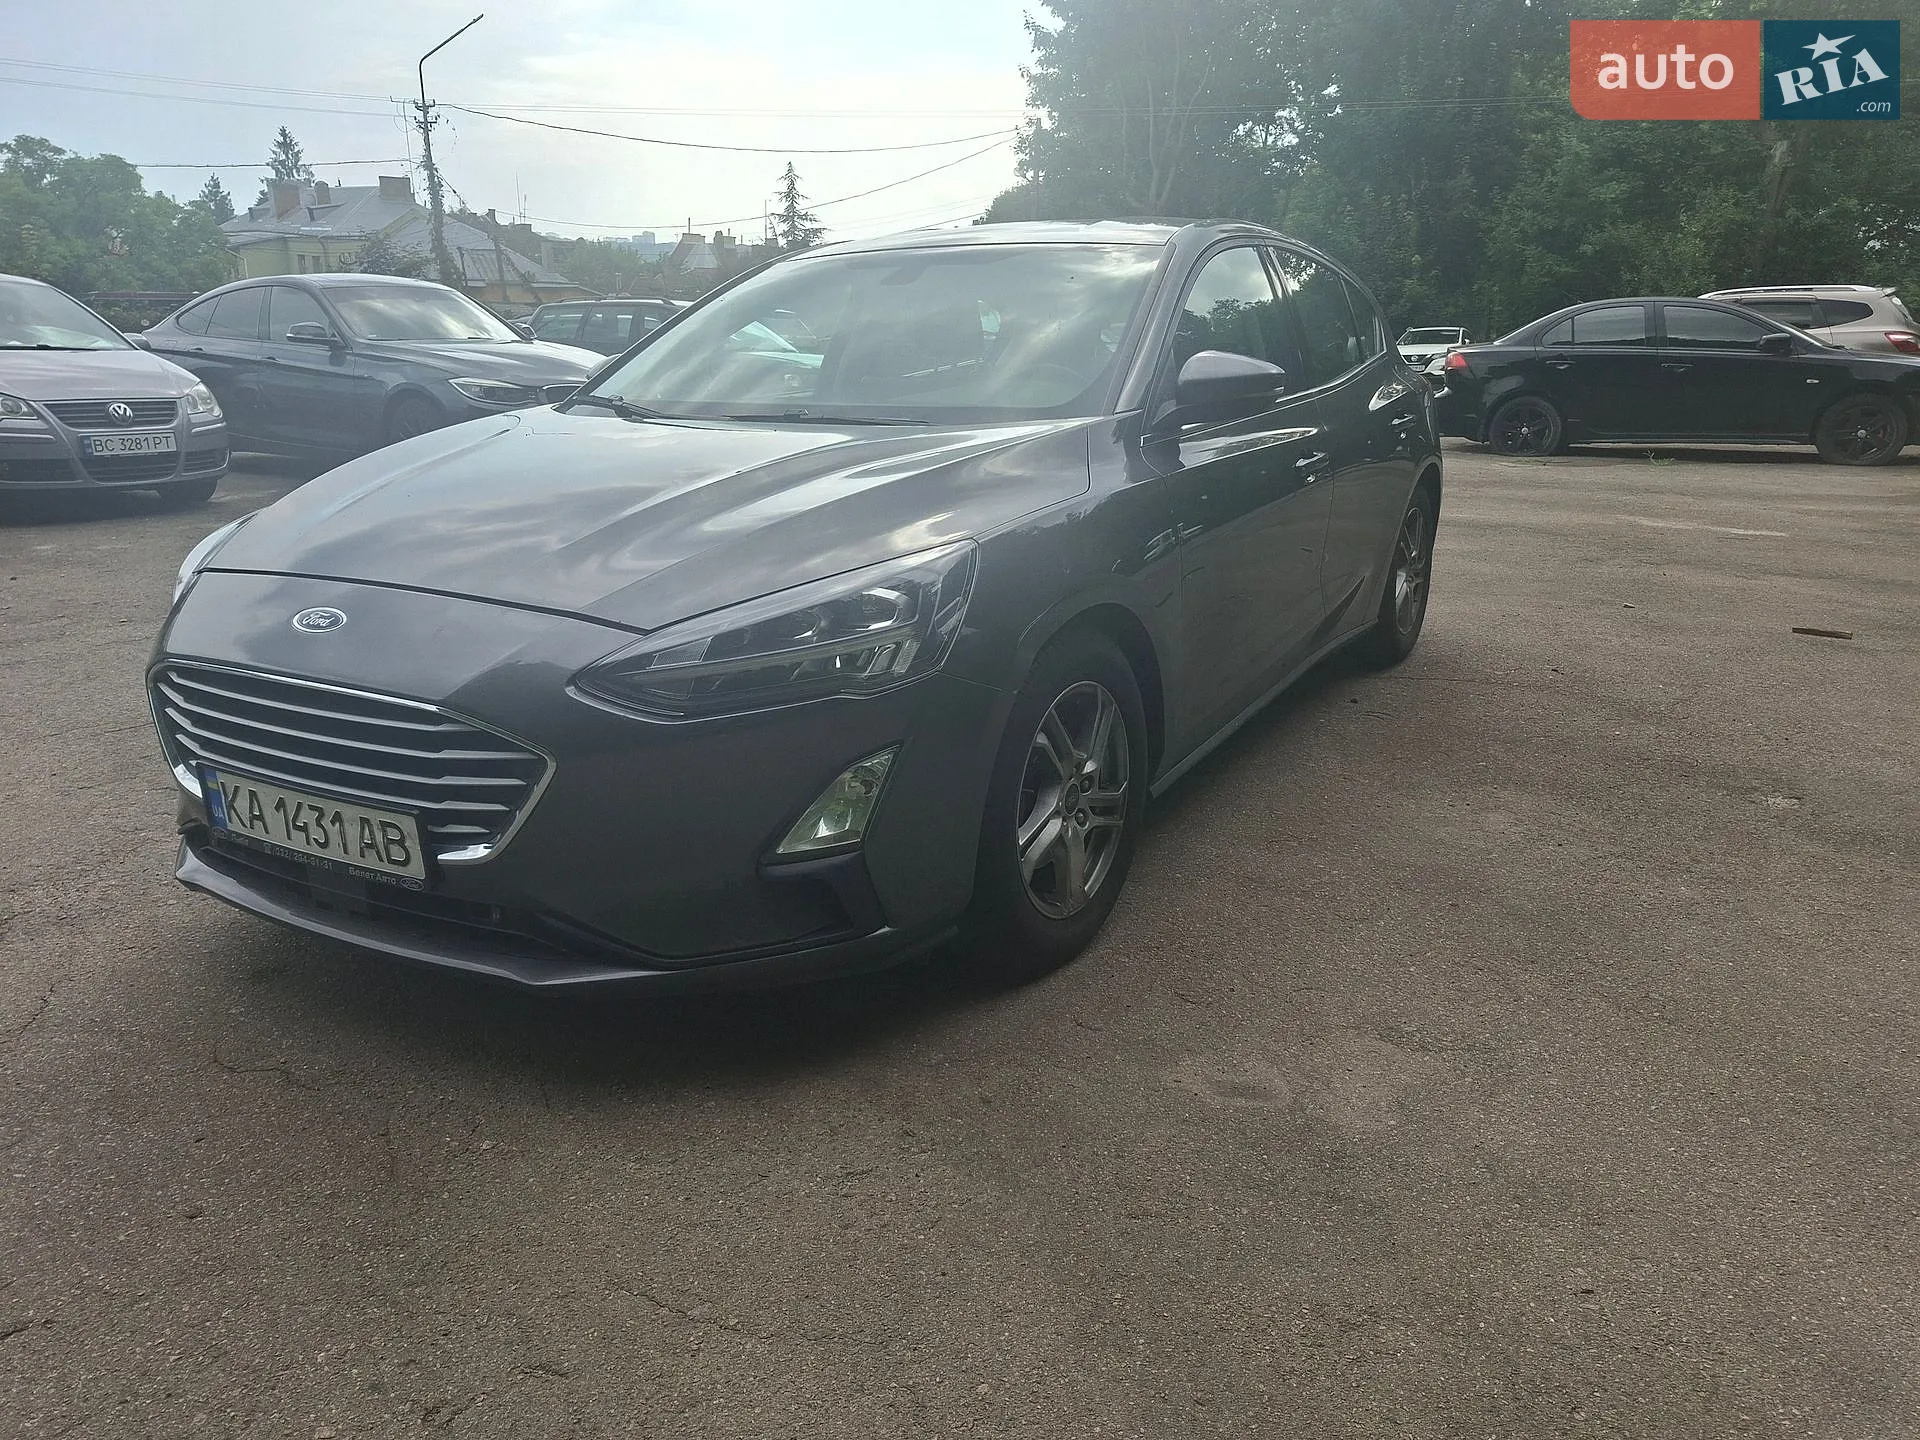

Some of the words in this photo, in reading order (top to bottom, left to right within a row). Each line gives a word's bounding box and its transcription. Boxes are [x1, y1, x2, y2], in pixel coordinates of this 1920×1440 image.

[93, 437, 115, 453] BC
[119, 437, 151, 452] 3281
[153, 435, 172, 450] PT
[220, 780, 269, 835] KA
[273, 795, 350, 856] 1431
[357, 815, 412, 867] AB
